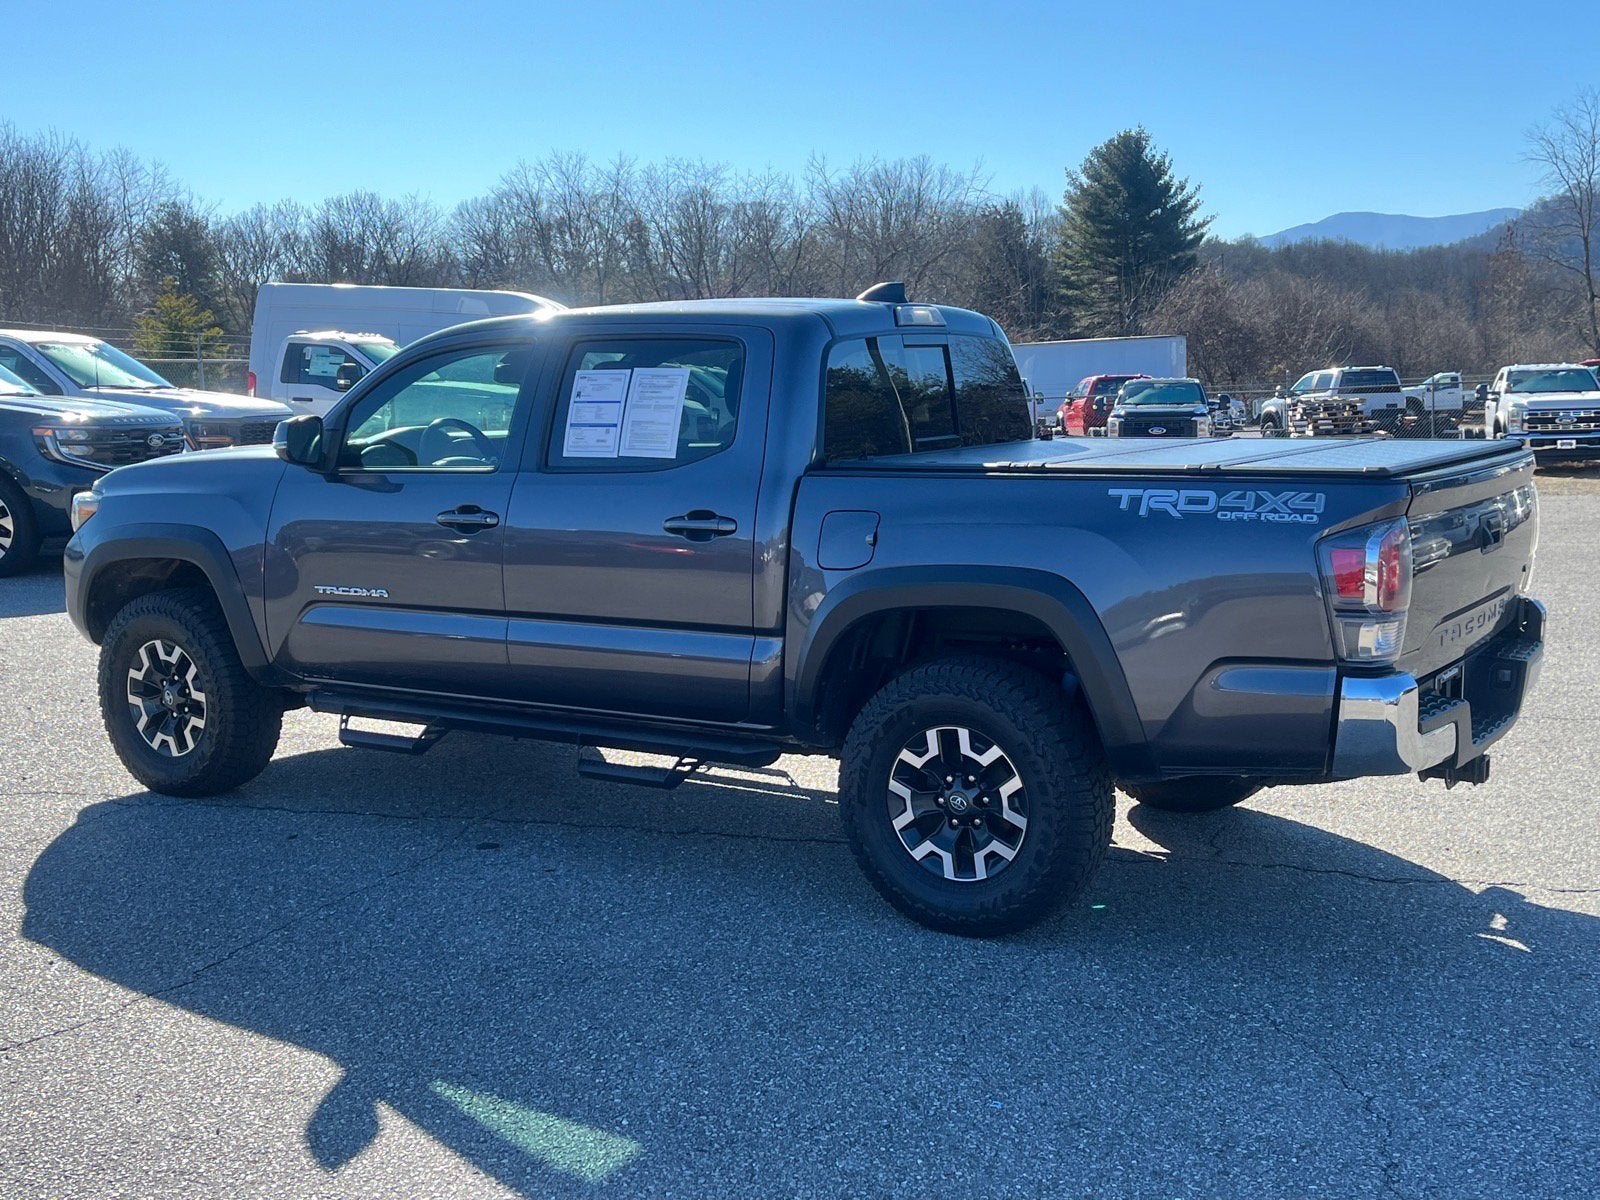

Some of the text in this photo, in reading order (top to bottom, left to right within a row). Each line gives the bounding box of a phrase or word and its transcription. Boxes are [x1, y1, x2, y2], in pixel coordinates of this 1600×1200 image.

[1108, 488, 1218, 519] TRD
[1216, 511, 1320, 524] OFF ROAD
[314, 585, 389, 598] TACOMA
